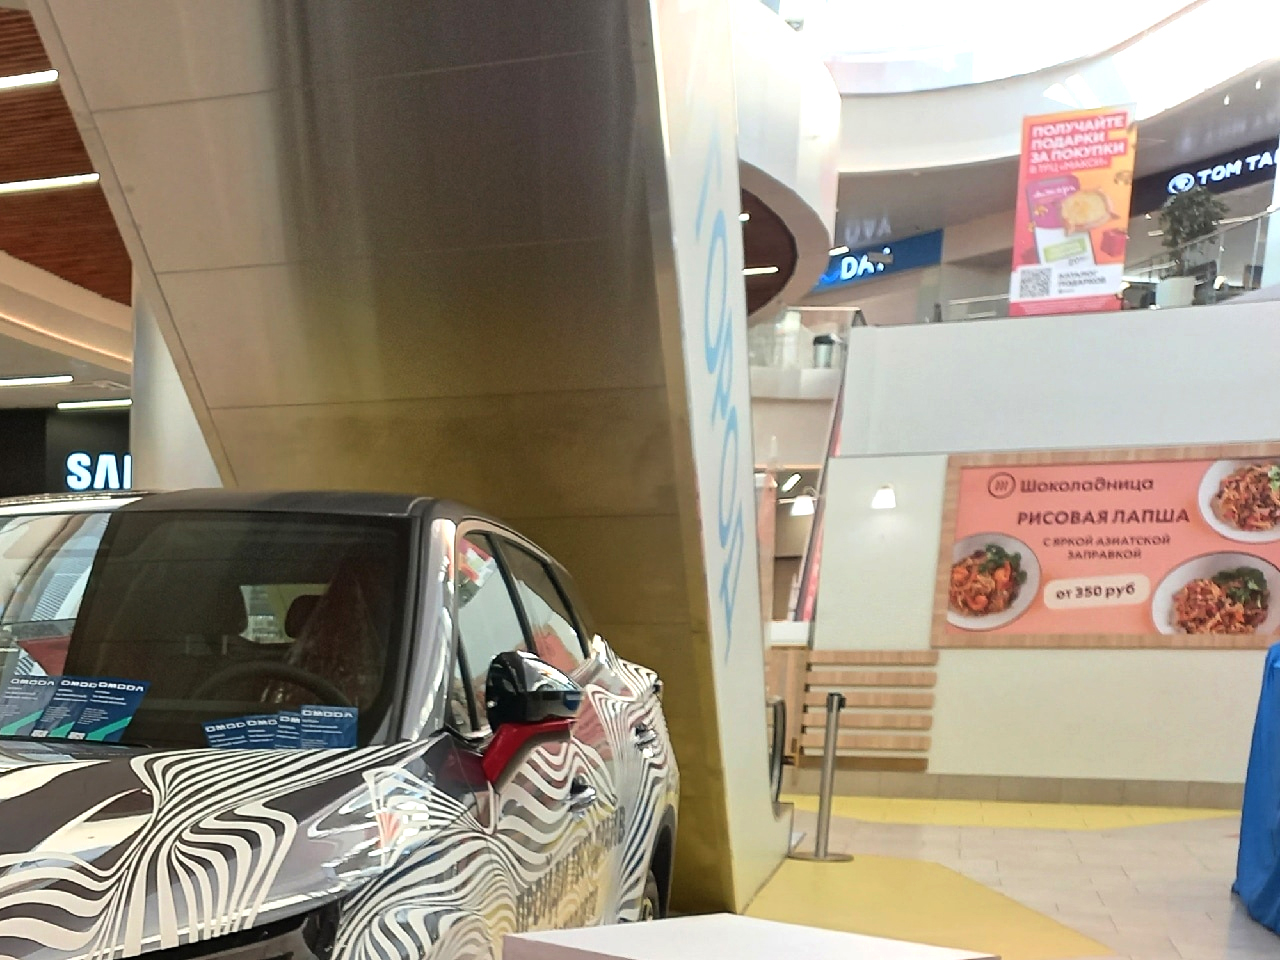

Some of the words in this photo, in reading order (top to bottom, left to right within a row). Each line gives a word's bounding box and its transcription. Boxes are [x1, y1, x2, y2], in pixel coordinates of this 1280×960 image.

[1031, 115, 1124, 138] ПОЛУЧАЙТЕ
[1031, 131, 1106, 150] ПОДАРКИ
[1030, 151, 1050, 164] ЗА
[1050, 142, 1125, 161] ПОКУПКИ
[1196, 159, 1243, 185] TOM
[1020, 477, 1154, 493] Шоколадница
[1017, 510, 1108, 526] РИСОВАЯ
[1111, 508, 1191, 524] ЛАПША
[1043, 537, 1052, 546] С
[1053, 535, 1093, 547] ЯРКОЙ
[1095, 533, 1171, 546] АЗИАТСКОЙ
[1067, 548, 1142, 560] ЗАПРАВКОЙ
[1056, 588, 1072, 600] от
[1074, 585, 1101, 599] 350
[1104, 582, 1136, 601] руб
[98, 681, 144, 692] OMODA
[301, 709, 354, 718] OMODA
